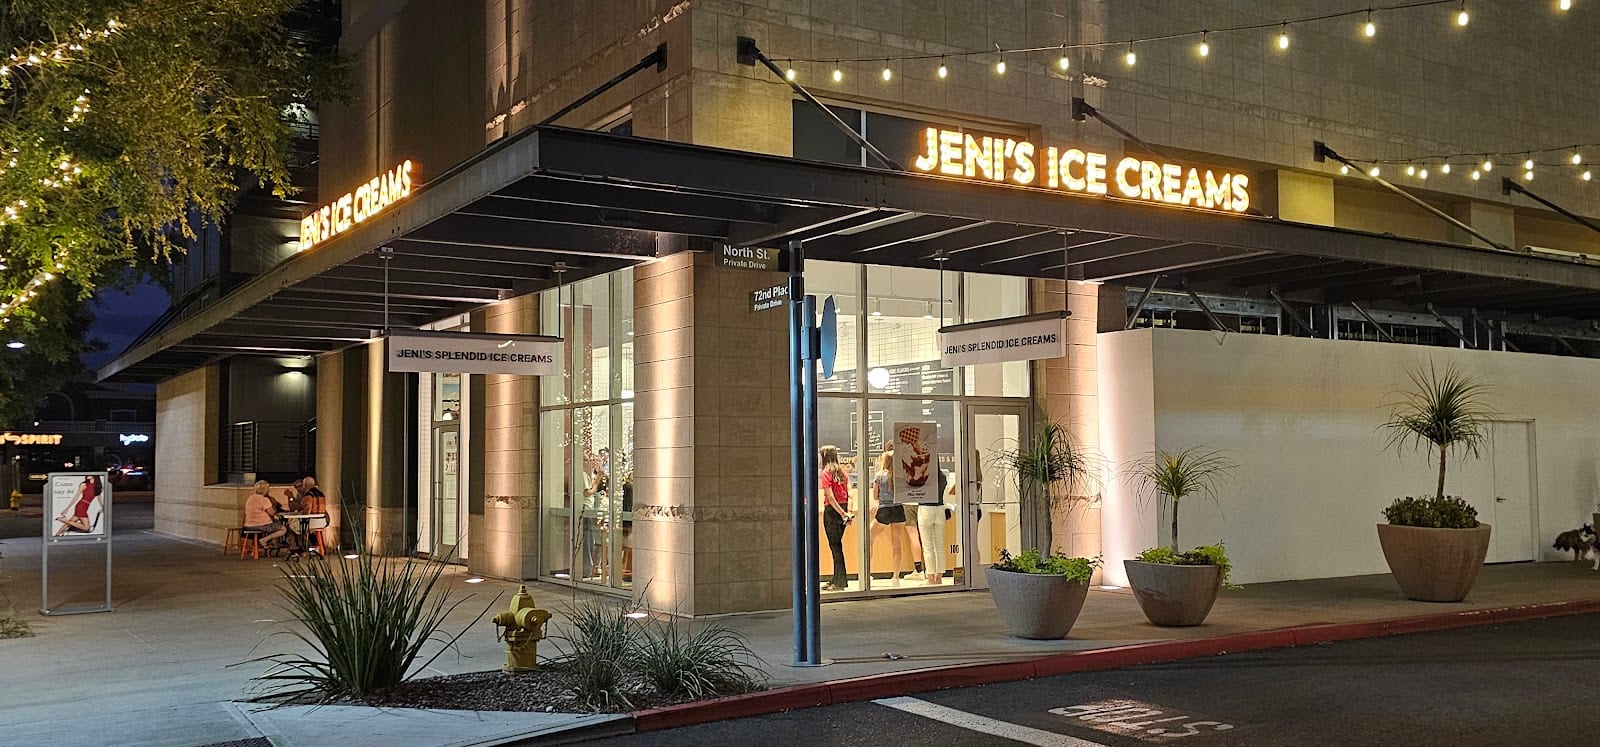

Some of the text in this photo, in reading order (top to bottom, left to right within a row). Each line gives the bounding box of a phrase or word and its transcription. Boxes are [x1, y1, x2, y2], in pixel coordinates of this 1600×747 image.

[914, 127, 1250, 213] JENI'S ICE CREAMS
[331, 192, 353, 236] ICE
[353, 159, 413, 223] CREAMS
[723, 244, 771, 260] North St.
[723, 258, 767, 270] Private Drive
[754, 285, 789, 302] 72nd Plac
[754, 299, 783, 312] Private Drive
[944, 333, 1057, 355] JENI'S SPLENDID ICE CREAMS
[397, 348, 553, 364] JENI'S SPLENDID ICE CREAMS
